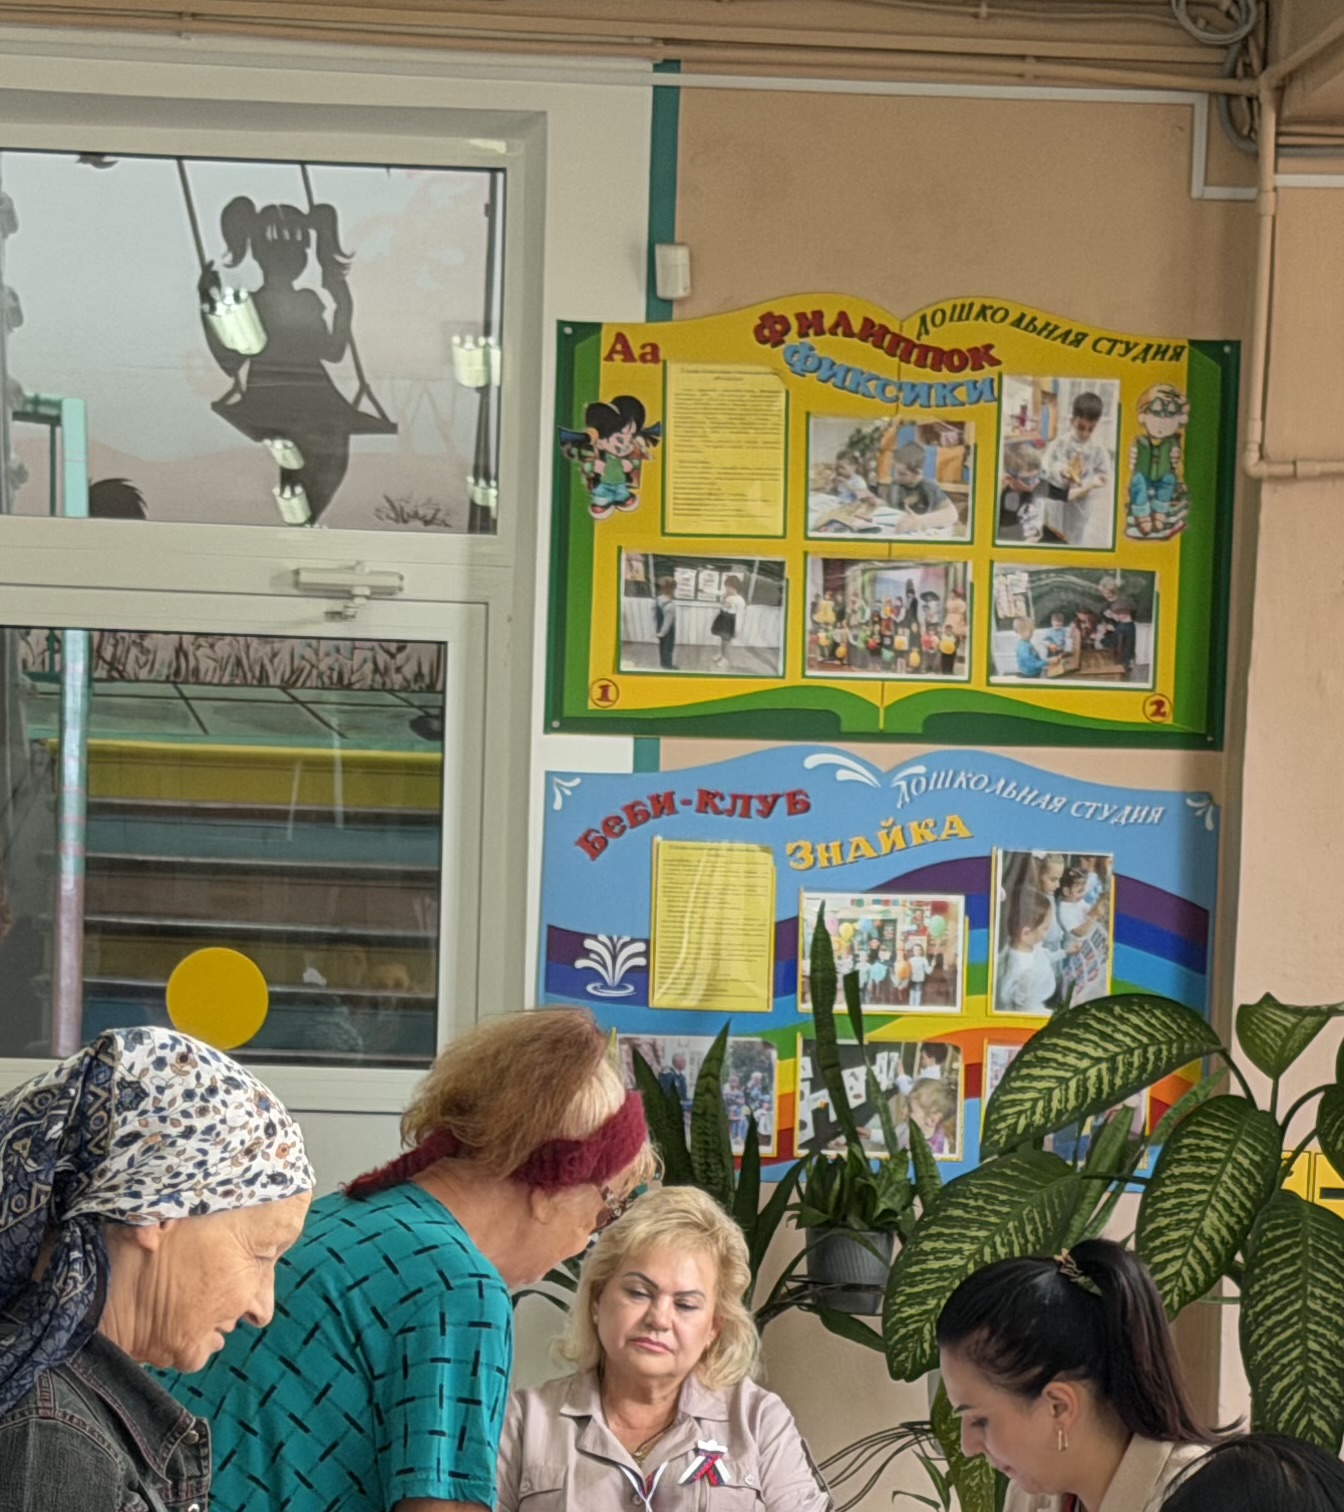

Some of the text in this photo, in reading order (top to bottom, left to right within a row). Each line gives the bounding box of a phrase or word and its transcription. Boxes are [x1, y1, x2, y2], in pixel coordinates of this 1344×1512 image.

[753, 309, 1003, 374] ФИЛИППОК
[916, 301, 1187, 364] ДОШКОЛЬНАЯ СТУДИЯ
[782, 341, 999, 408] ФИКСИКИ
[1148, 699, 1168, 718] 2
[785, 814, 974, 872] ЗНАЙКА
[1069, 800, 1167, 826] СТУДИЯ
